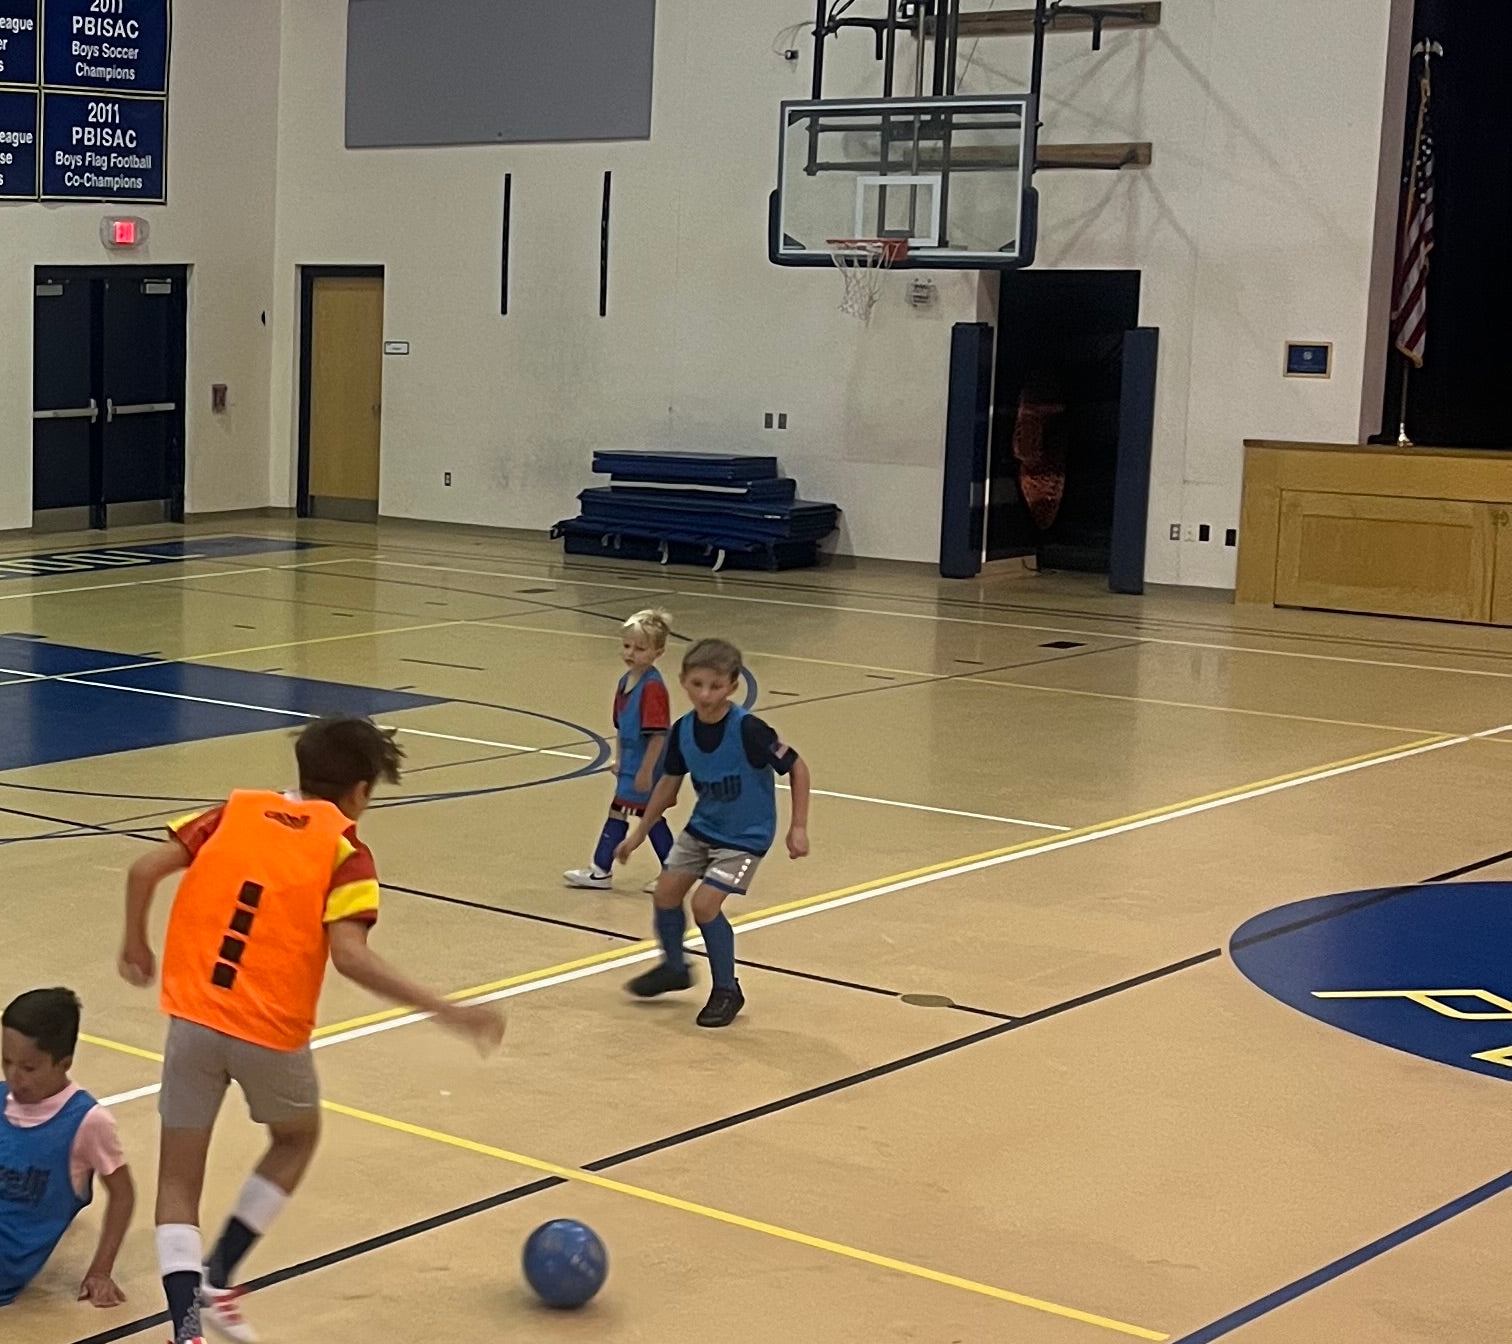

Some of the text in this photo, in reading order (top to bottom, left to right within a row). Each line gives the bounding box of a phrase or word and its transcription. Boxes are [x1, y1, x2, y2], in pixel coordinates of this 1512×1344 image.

[72, 15, 139, 39] PBISAC
[72, 40, 139, 60] Boys Soccer
[75, 61, 135, 82] Champions
[88, 102, 120, 124] 2011
[72, 126, 137, 148] PBISAC
[55, 151, 152, 171] Boys Flag Football
[64, 171, 143, 191] Co-Champions
